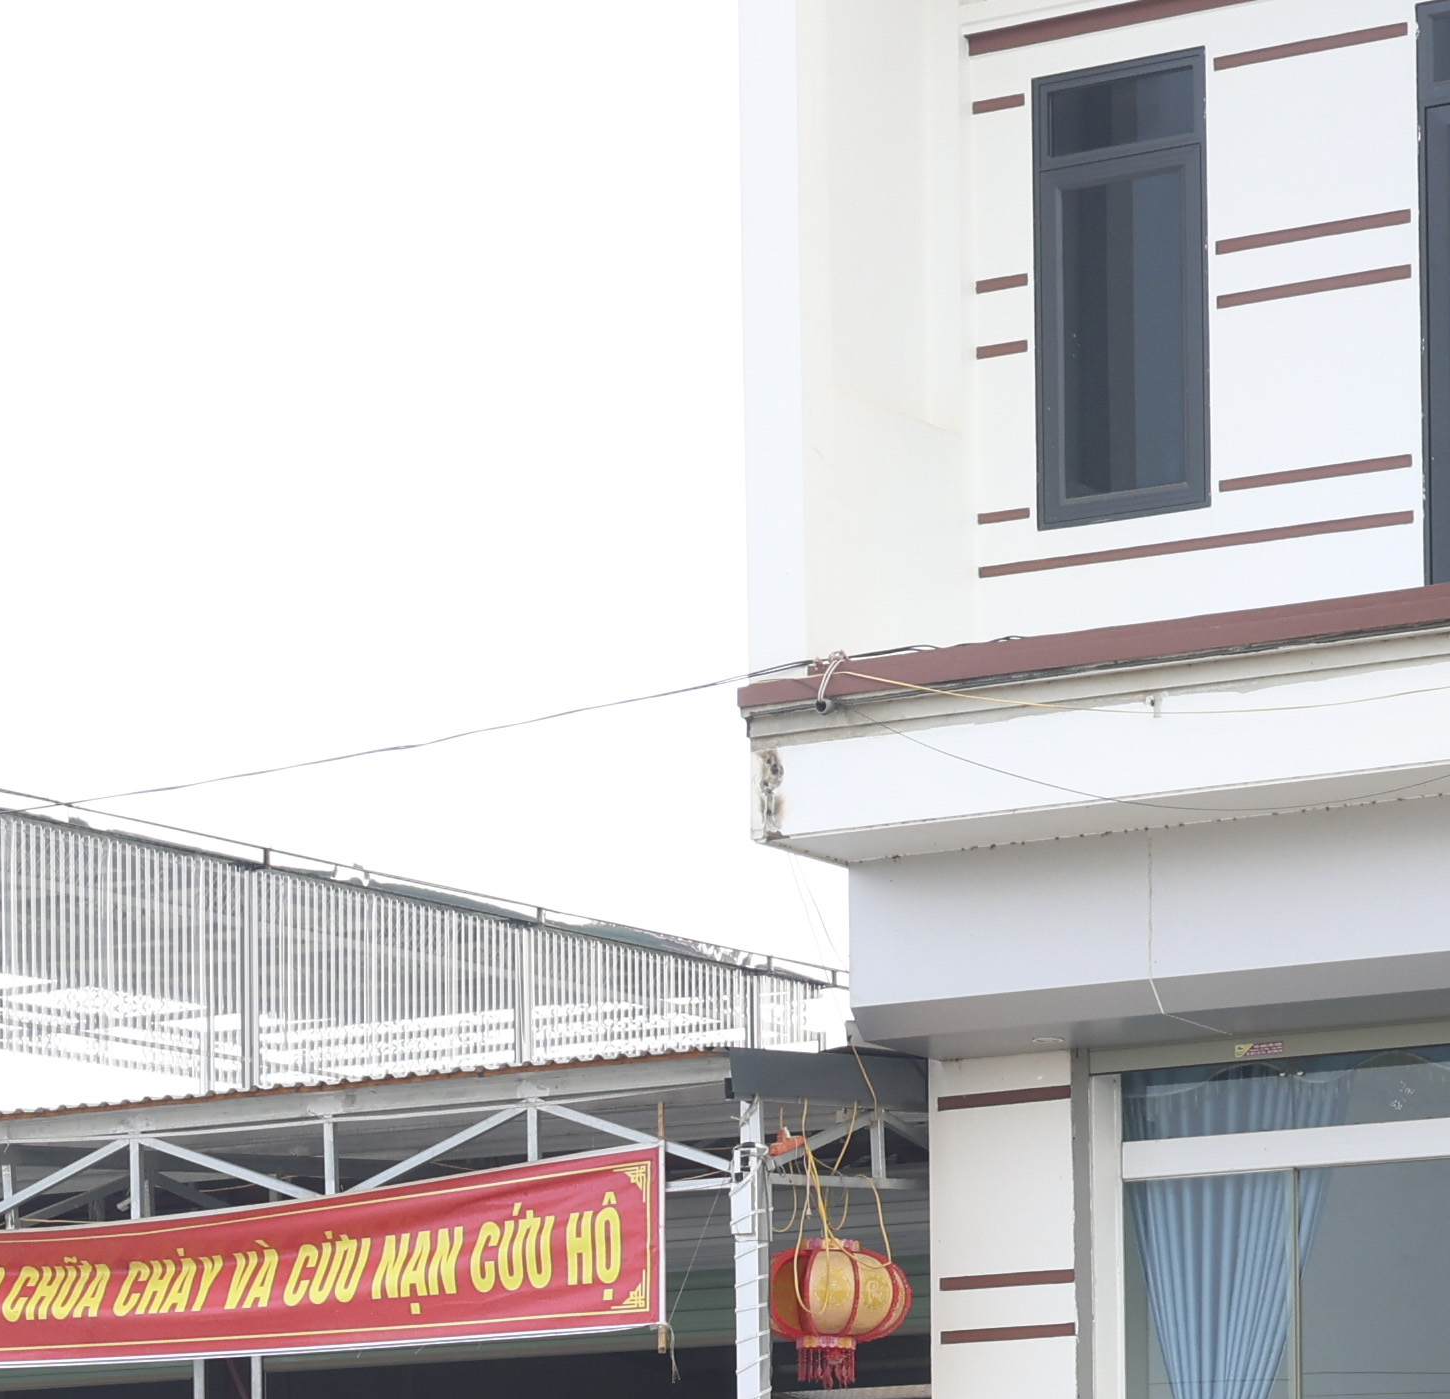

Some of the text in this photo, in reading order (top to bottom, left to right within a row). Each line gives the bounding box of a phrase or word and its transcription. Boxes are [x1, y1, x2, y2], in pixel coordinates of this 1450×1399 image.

[1, 1256, 111, 1323] CHỮA
[224, 1239, 280, 1310] VÀ
[371, 1225, 464, 1315] NẠN
[470, 1201, 556, 1294] CỨU
[565, 1191, 623, 1301] HỘ
